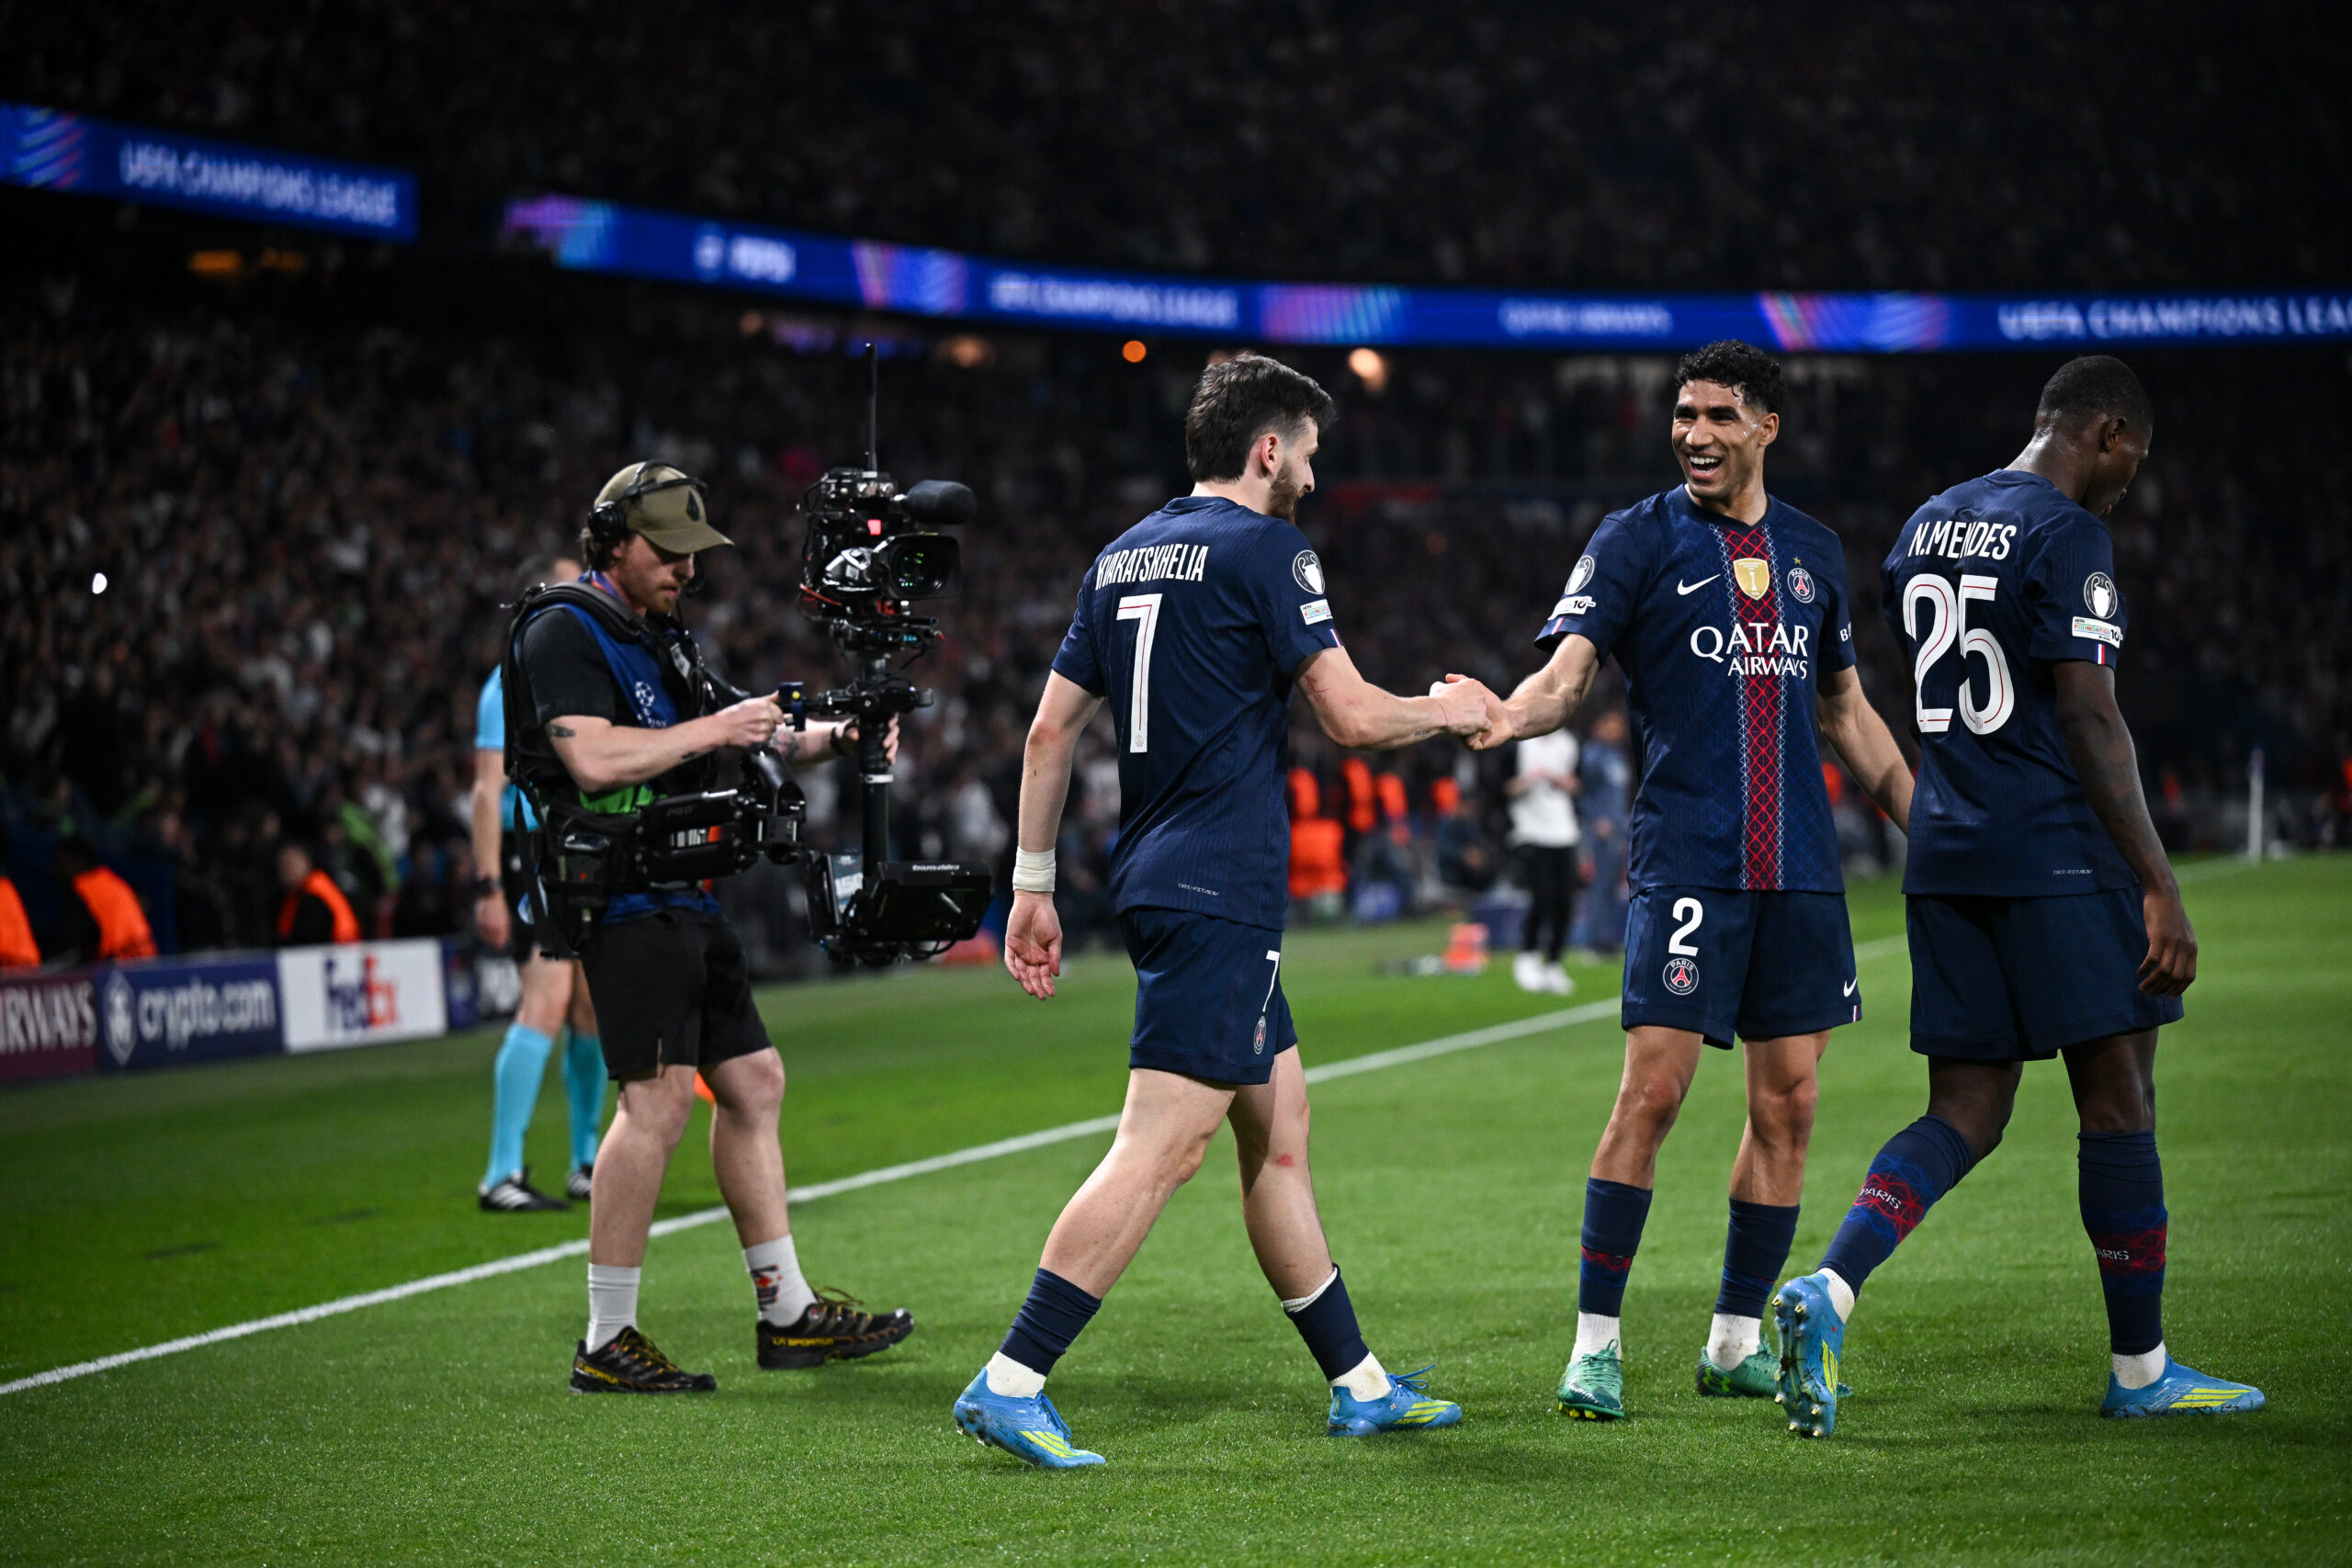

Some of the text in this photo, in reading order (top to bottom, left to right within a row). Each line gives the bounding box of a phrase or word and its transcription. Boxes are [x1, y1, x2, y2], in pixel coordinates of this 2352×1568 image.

[1997, 300, 2086, 340] UEFA
[2087, 298, 2284, 338] CHAMPIONS
[1690, 622, 1809, 664] QATAR
[1903, 573, 2016, 736] 25
[1115, 592, 1164, 754] 7
[1727, 656, 1808, 680] AIRWAYS
[1668, 897, 1703, 957] 2
[1261, 949, 1281, 1012] 7
[1670, 959, 1694, 972] PARIS
[1859, 1188, 1903, 1210] PARIS
[2095, 1247, 2131, 1261] ARIS
